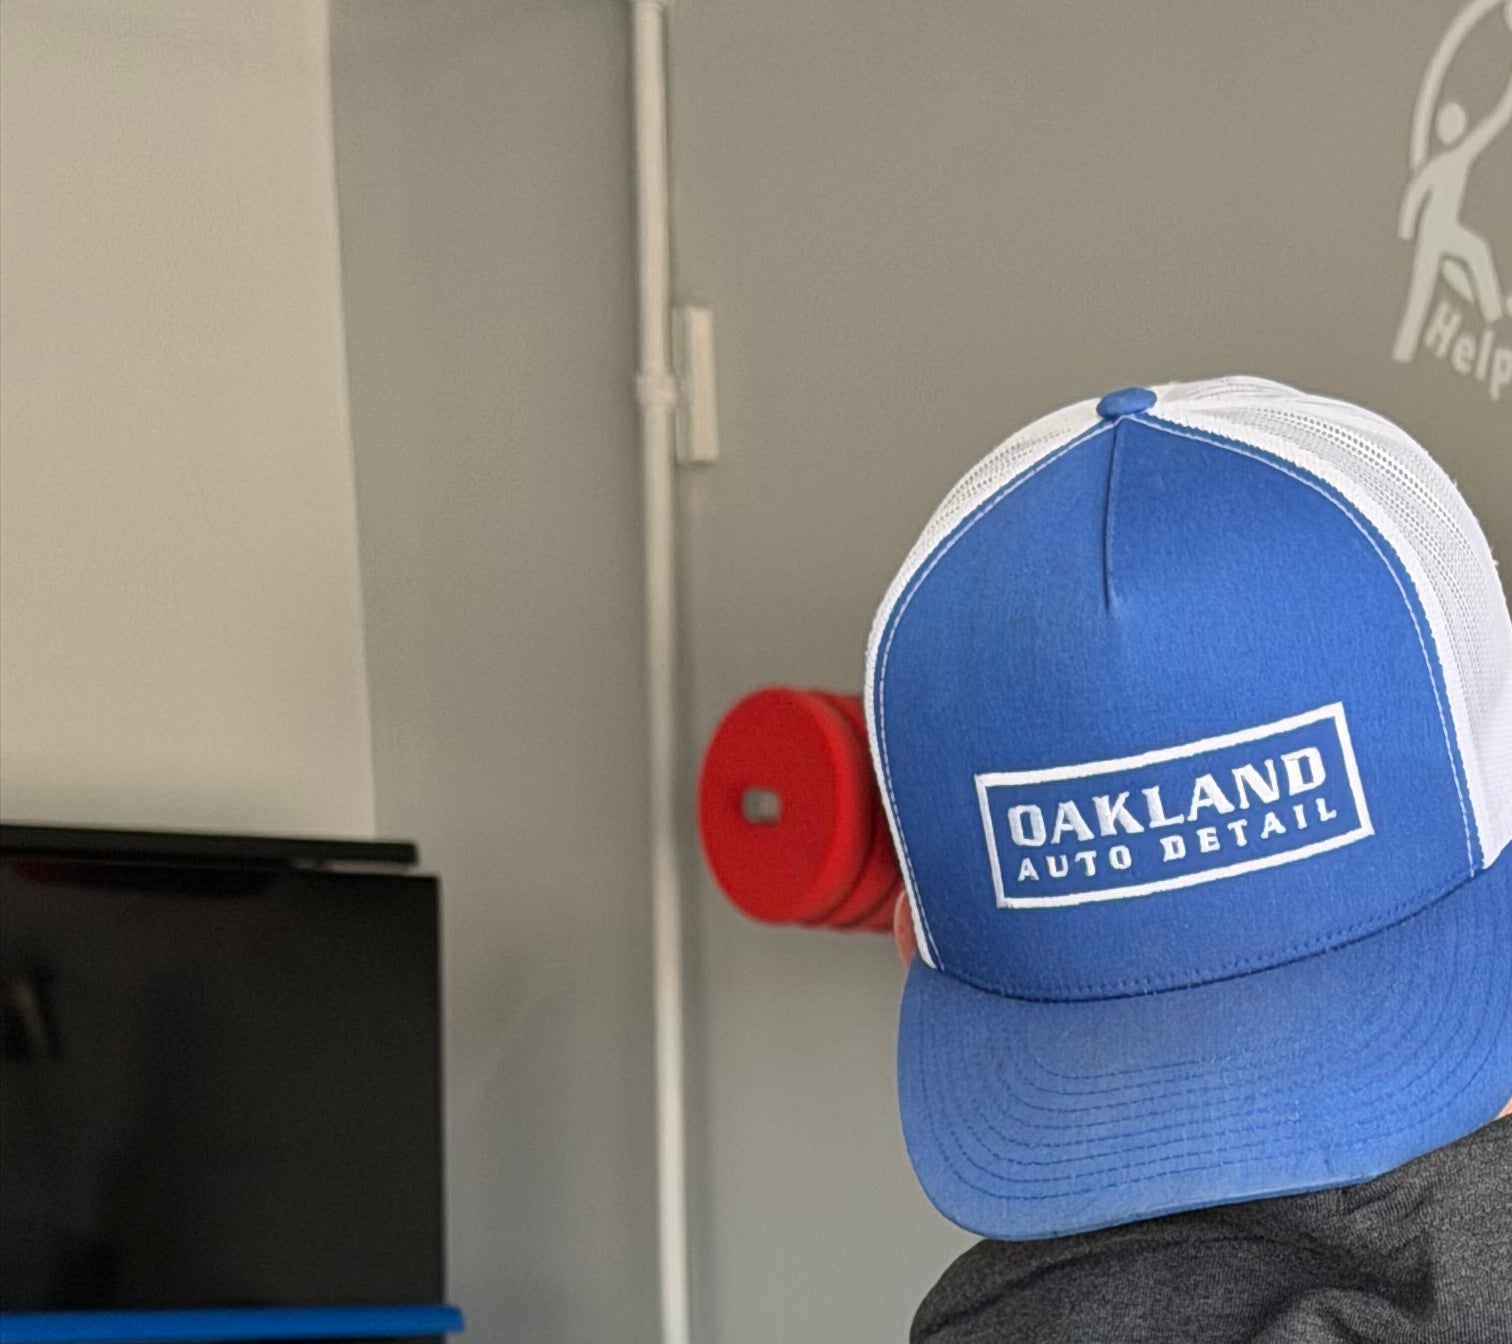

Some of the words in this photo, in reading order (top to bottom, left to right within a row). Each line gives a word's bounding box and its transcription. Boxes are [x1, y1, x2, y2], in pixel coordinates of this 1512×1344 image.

[1006, 745, 1328, 848] OAKLAND
[1017, 844, 1133, 882] AUTO
[1158, 796, 1339, 863] DETAIL
